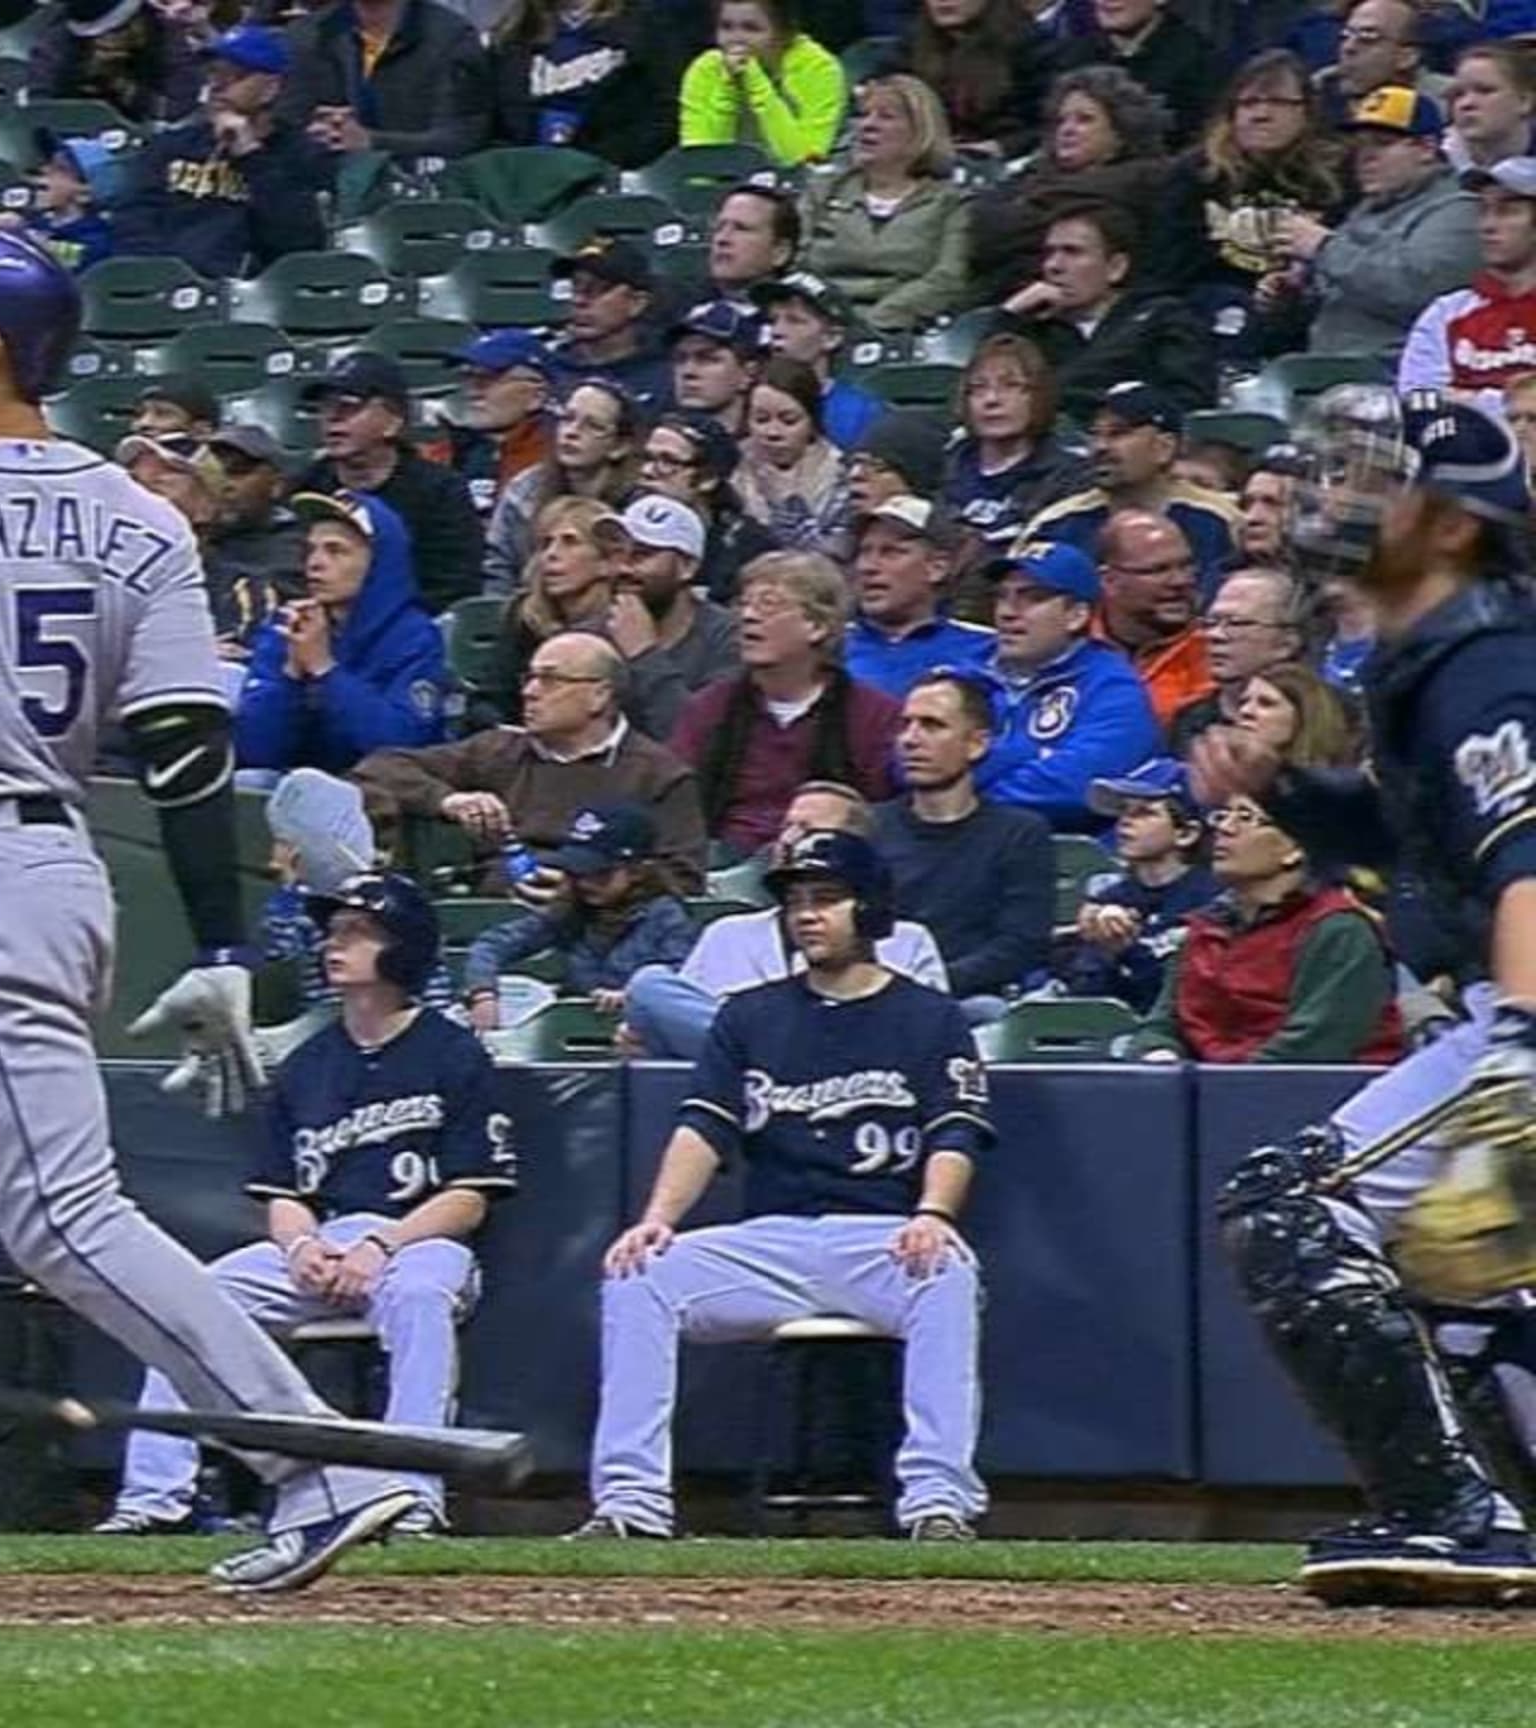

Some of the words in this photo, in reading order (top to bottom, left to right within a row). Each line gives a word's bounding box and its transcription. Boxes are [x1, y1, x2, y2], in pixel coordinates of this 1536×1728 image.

[13, 586, 98, 740] 5
[743, 1069, 917, 1131] Brewers
[293, 1094, 444, 1194] Brewers
[849, 1122, 923, 1174] 99
